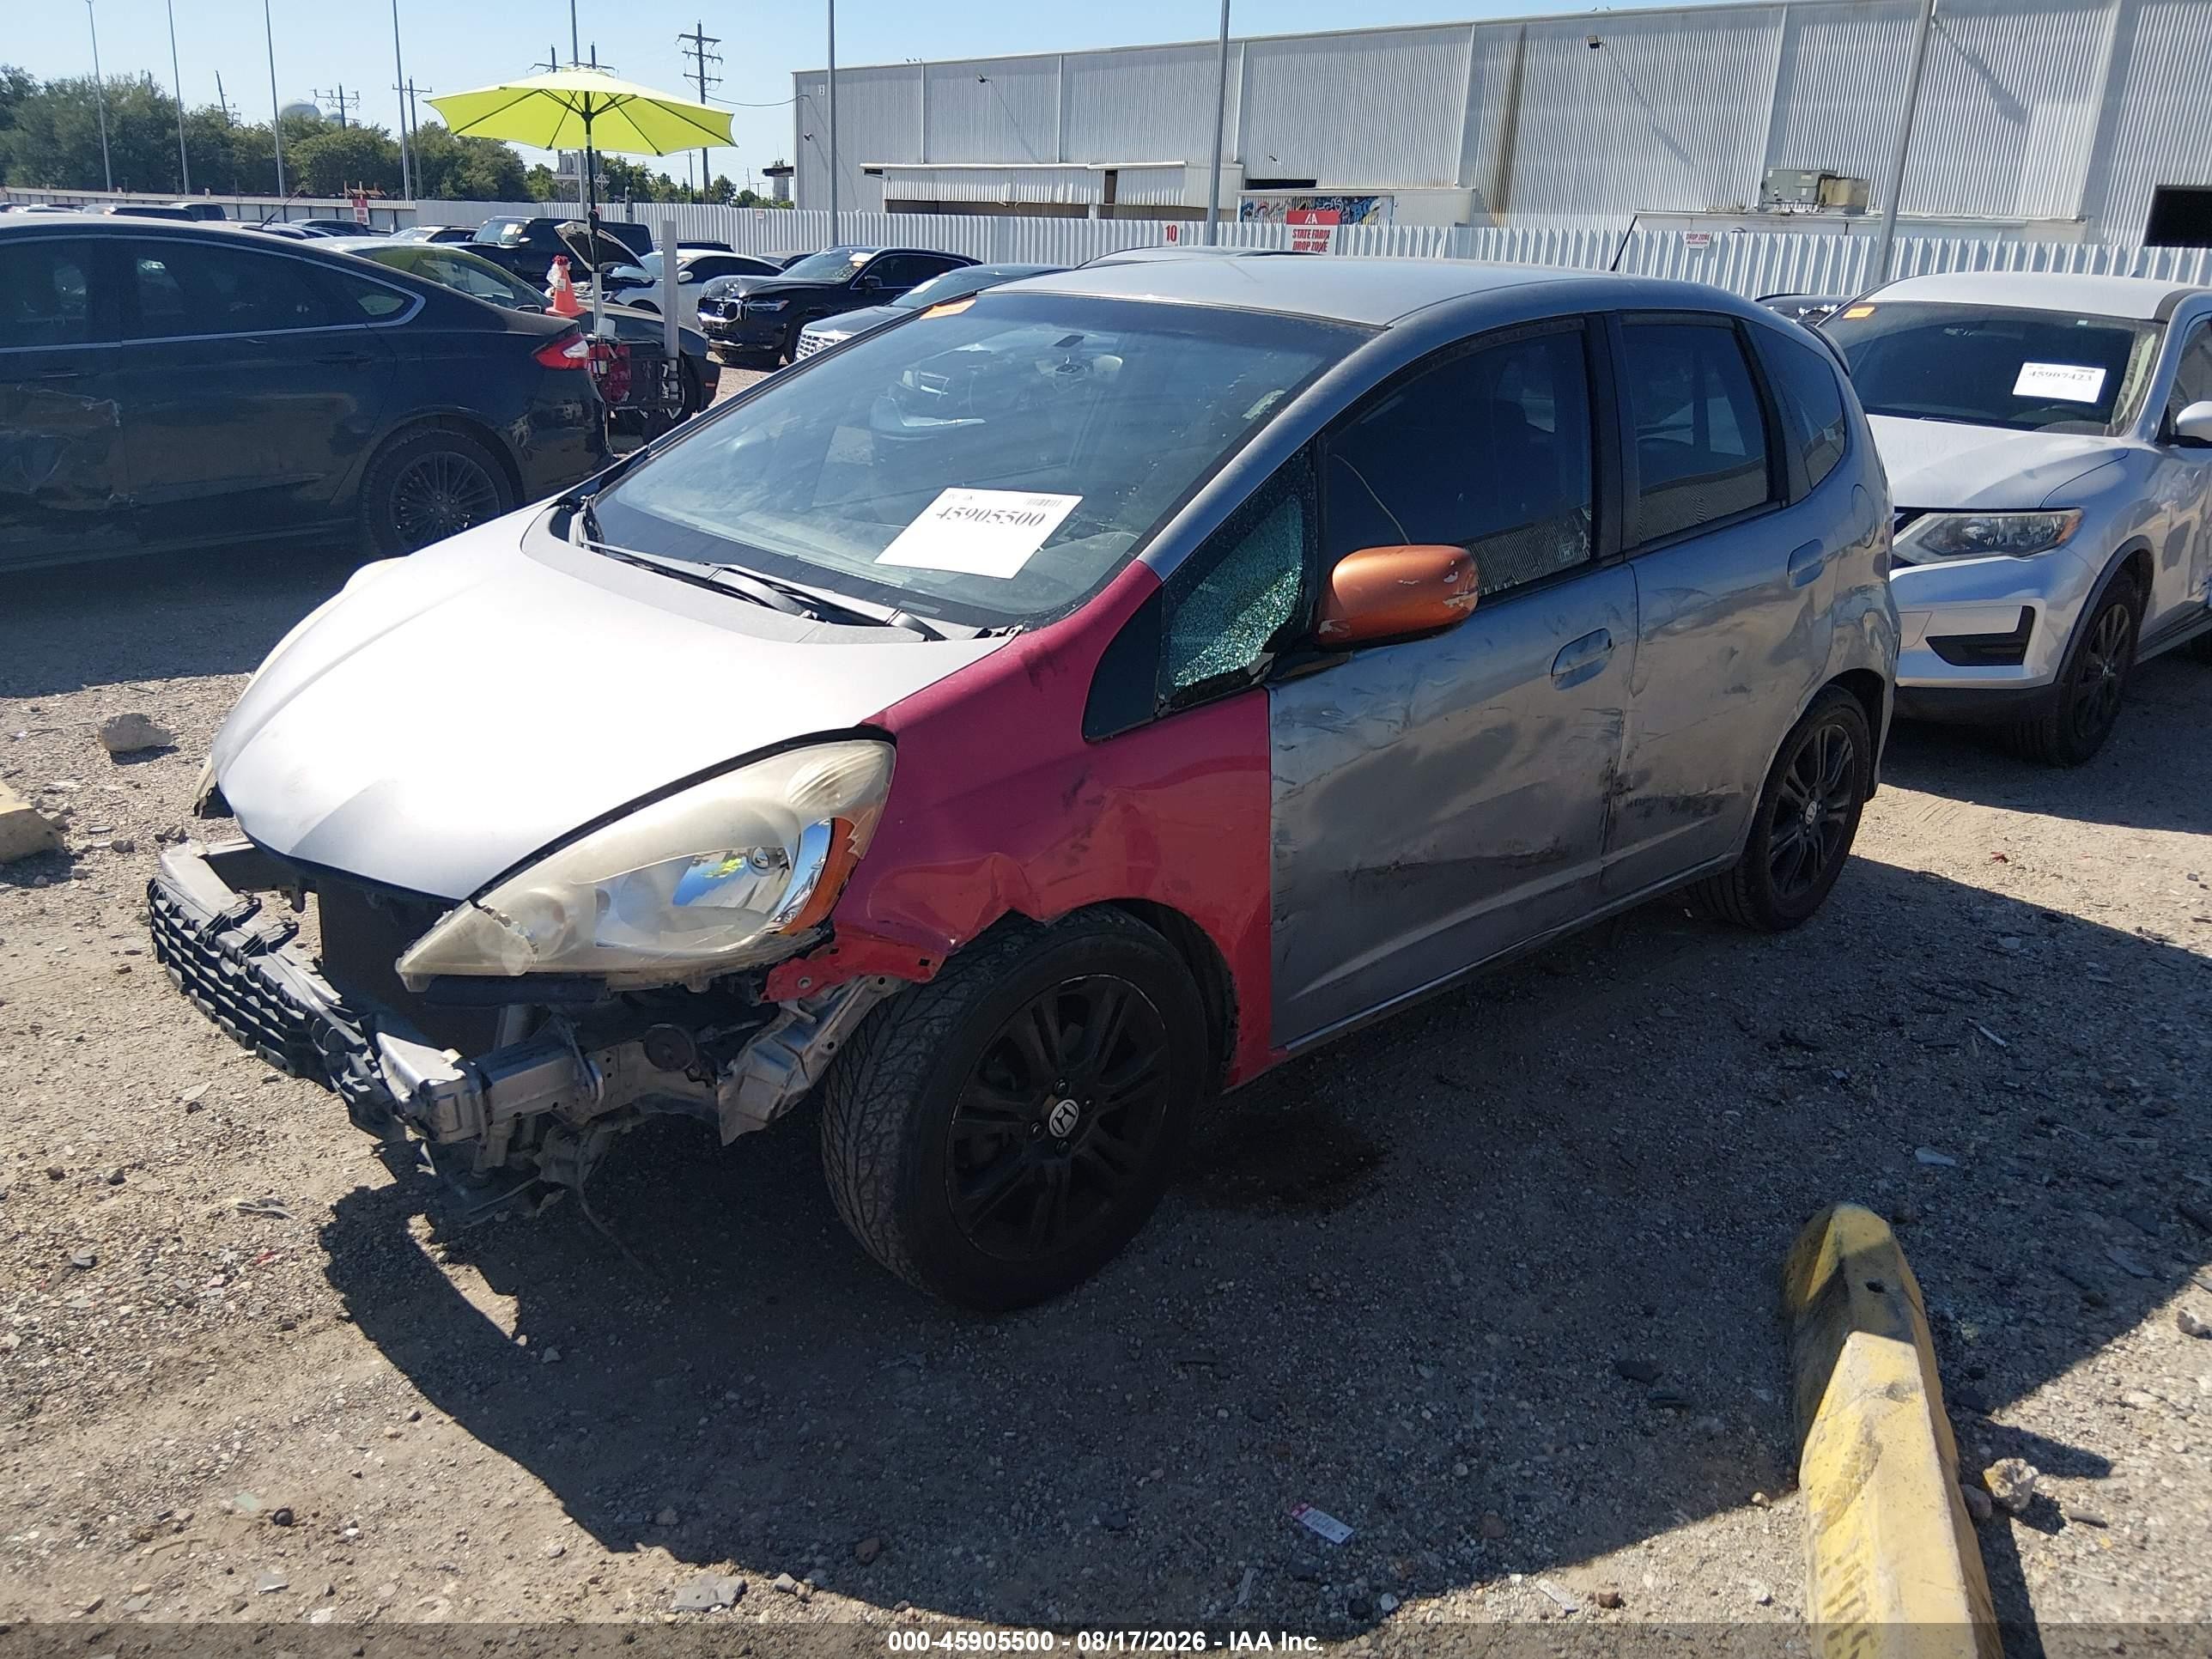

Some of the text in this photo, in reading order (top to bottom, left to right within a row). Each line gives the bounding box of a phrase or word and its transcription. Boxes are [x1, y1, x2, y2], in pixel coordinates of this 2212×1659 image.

[1164, 224, 1177, 242] 10
[1292, 228, 1330, 240] STATE FARM
[1292, 241, 1311, 251] DROP
[936, 507, 1047, 527] 45905500
